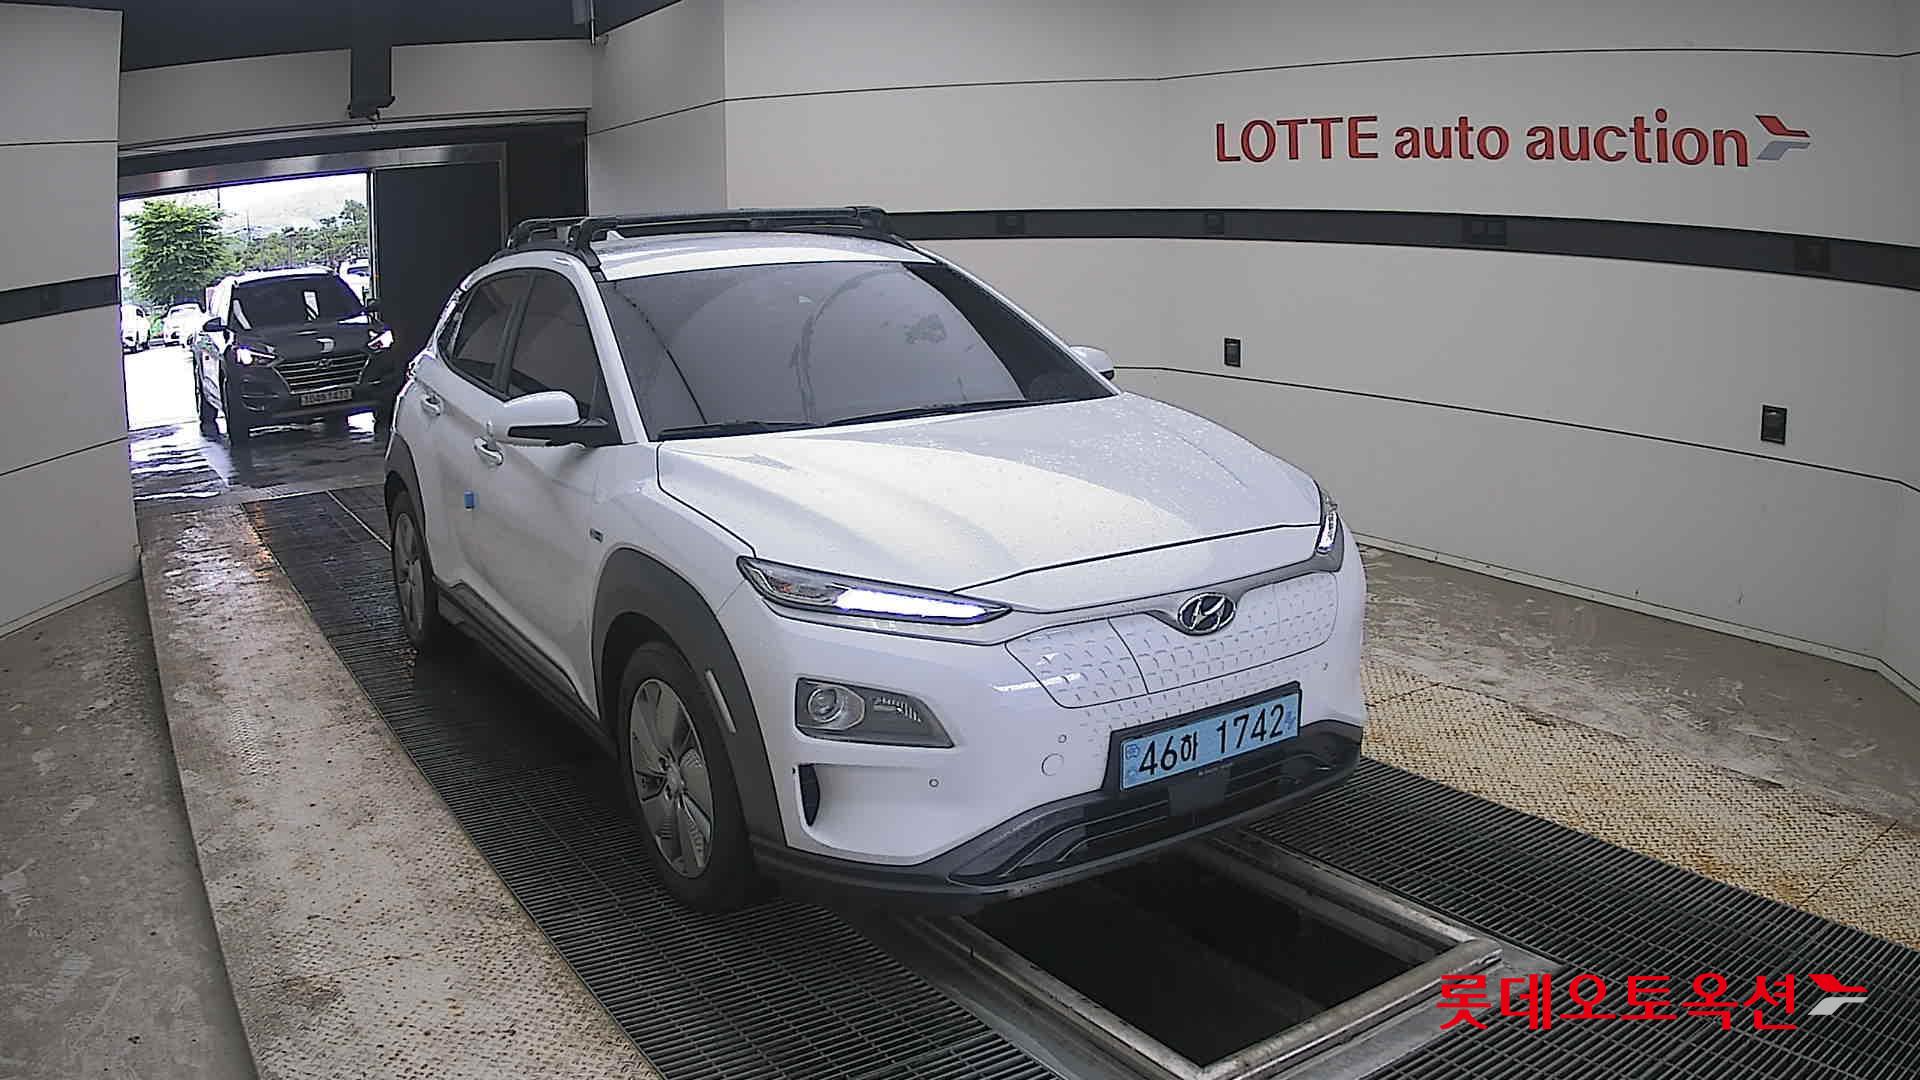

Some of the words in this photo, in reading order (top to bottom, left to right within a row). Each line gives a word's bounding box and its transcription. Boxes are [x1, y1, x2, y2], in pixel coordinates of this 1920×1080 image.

[1216, 116, 1378, 162] LOTTE
[1393, 116, 1510, 161] auto
[1525, 108, 1750, 167] auction
[1138, 731, 1199, 775] 46하
[1216, 703, 1285, 754] 1742
